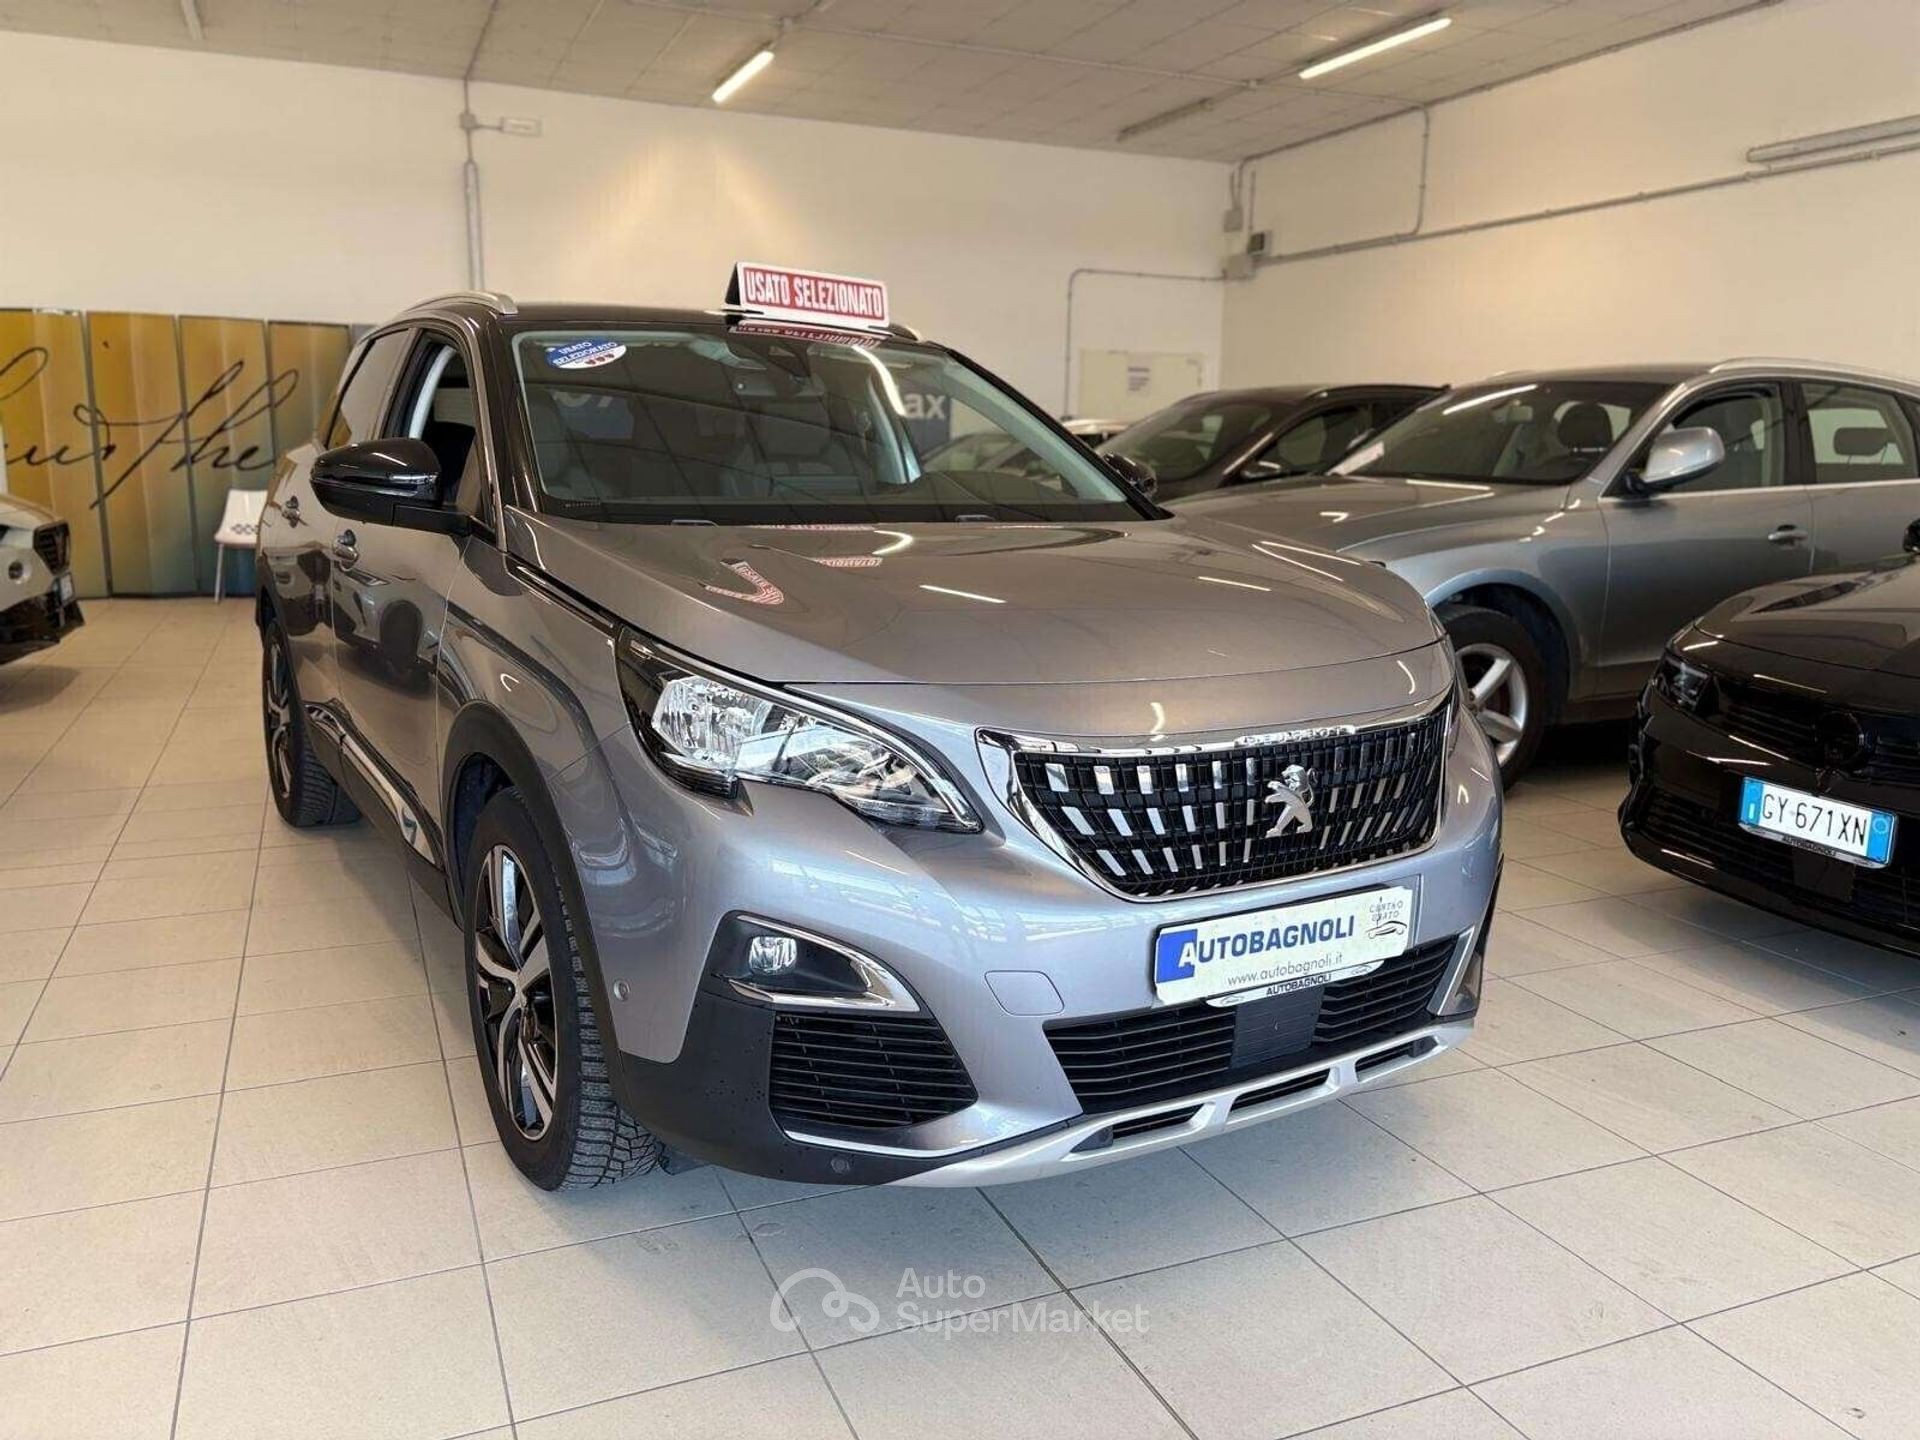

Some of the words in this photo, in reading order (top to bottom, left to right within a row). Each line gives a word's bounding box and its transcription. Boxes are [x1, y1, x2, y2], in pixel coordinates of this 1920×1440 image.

[745, 270, 790, 306] USATO
[793, 276, 883, 318] SELEZIONATO
[1178, 916, 1355, 968] AUTOBAGNOLI
[1227, 951, 1344, 987] www.autobagnoli.it
[1265, 973, 1332, 997] AUTOBAGNOLI
